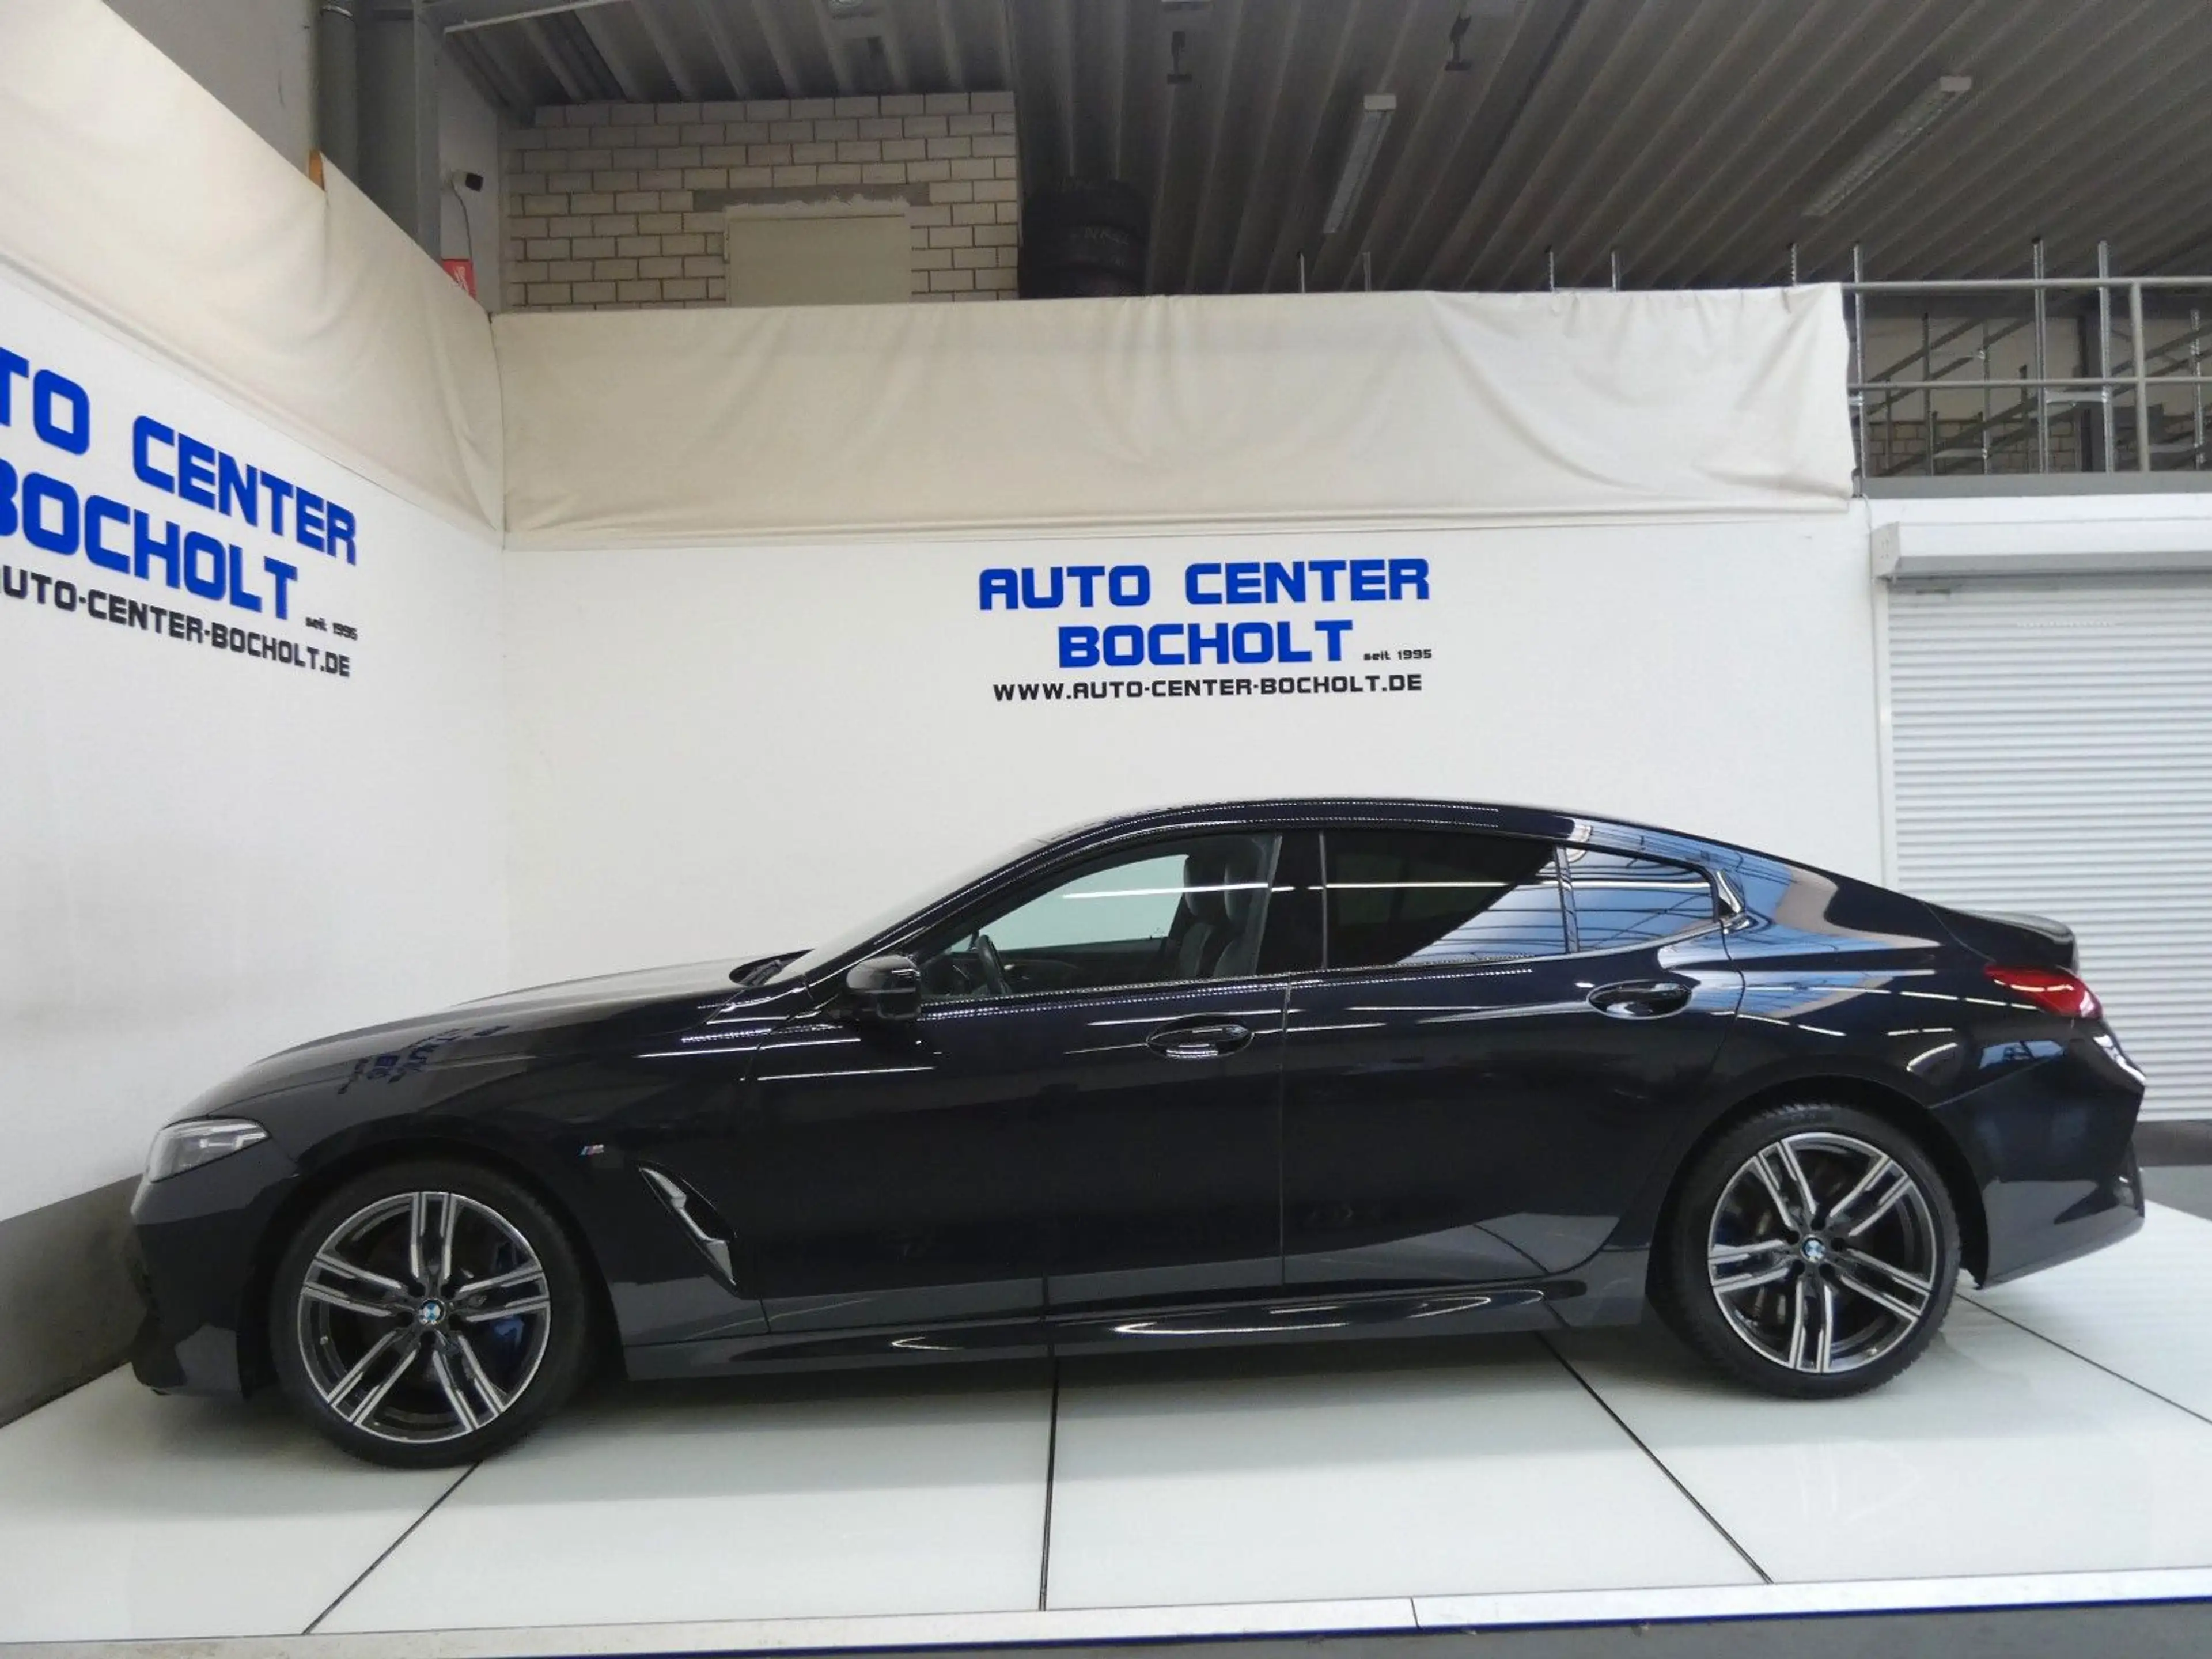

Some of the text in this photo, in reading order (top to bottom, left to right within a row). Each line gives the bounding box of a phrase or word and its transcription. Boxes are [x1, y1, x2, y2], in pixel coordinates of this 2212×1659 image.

[133, 415, 357, 565] CENTER
[979, 558, 1430, 611] AUTO CENTER
[1058, 619, 1353, 668] BOCHOLT
[1363, 649, 1432, 661] seit 1995
[993, 674, 1422, 702] WWW.AUTO-CENTER-BOCHOLT.DE
